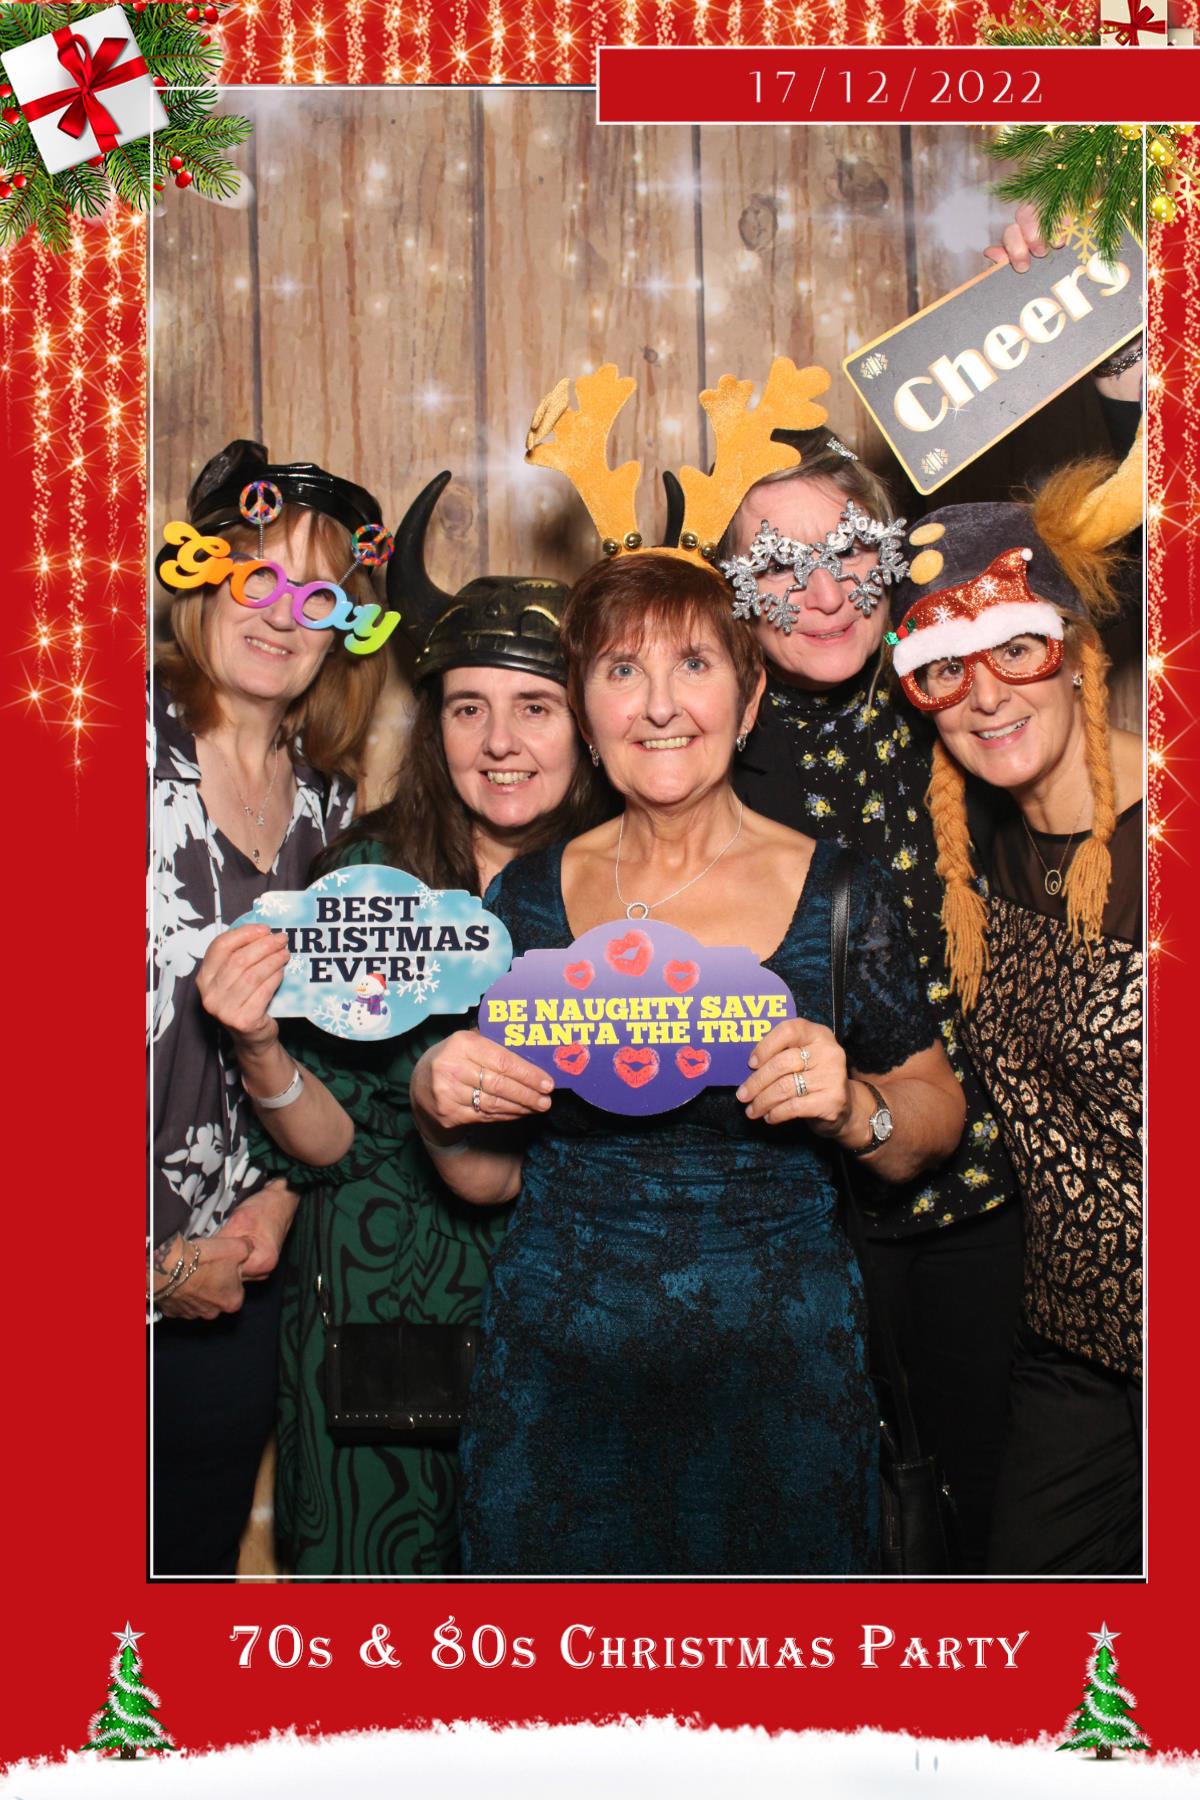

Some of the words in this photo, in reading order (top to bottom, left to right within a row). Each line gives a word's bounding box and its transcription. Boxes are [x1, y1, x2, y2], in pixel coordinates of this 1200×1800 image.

[894, 250, 1131, 432] Cheers
[316, 896, 420, 923] BEST
[309, 956, 426, 983] EVER!
[487, 1000, 528, 1023] BE
[534, 996, 694, 1023] NAUGHTY
[699, 995, 788, 1019] SAVE
[504, 1021, 620, 1046] SANTA
[626, 1020, 691, 1044] THE
[697, 1019, 772, 1043] TRIP
